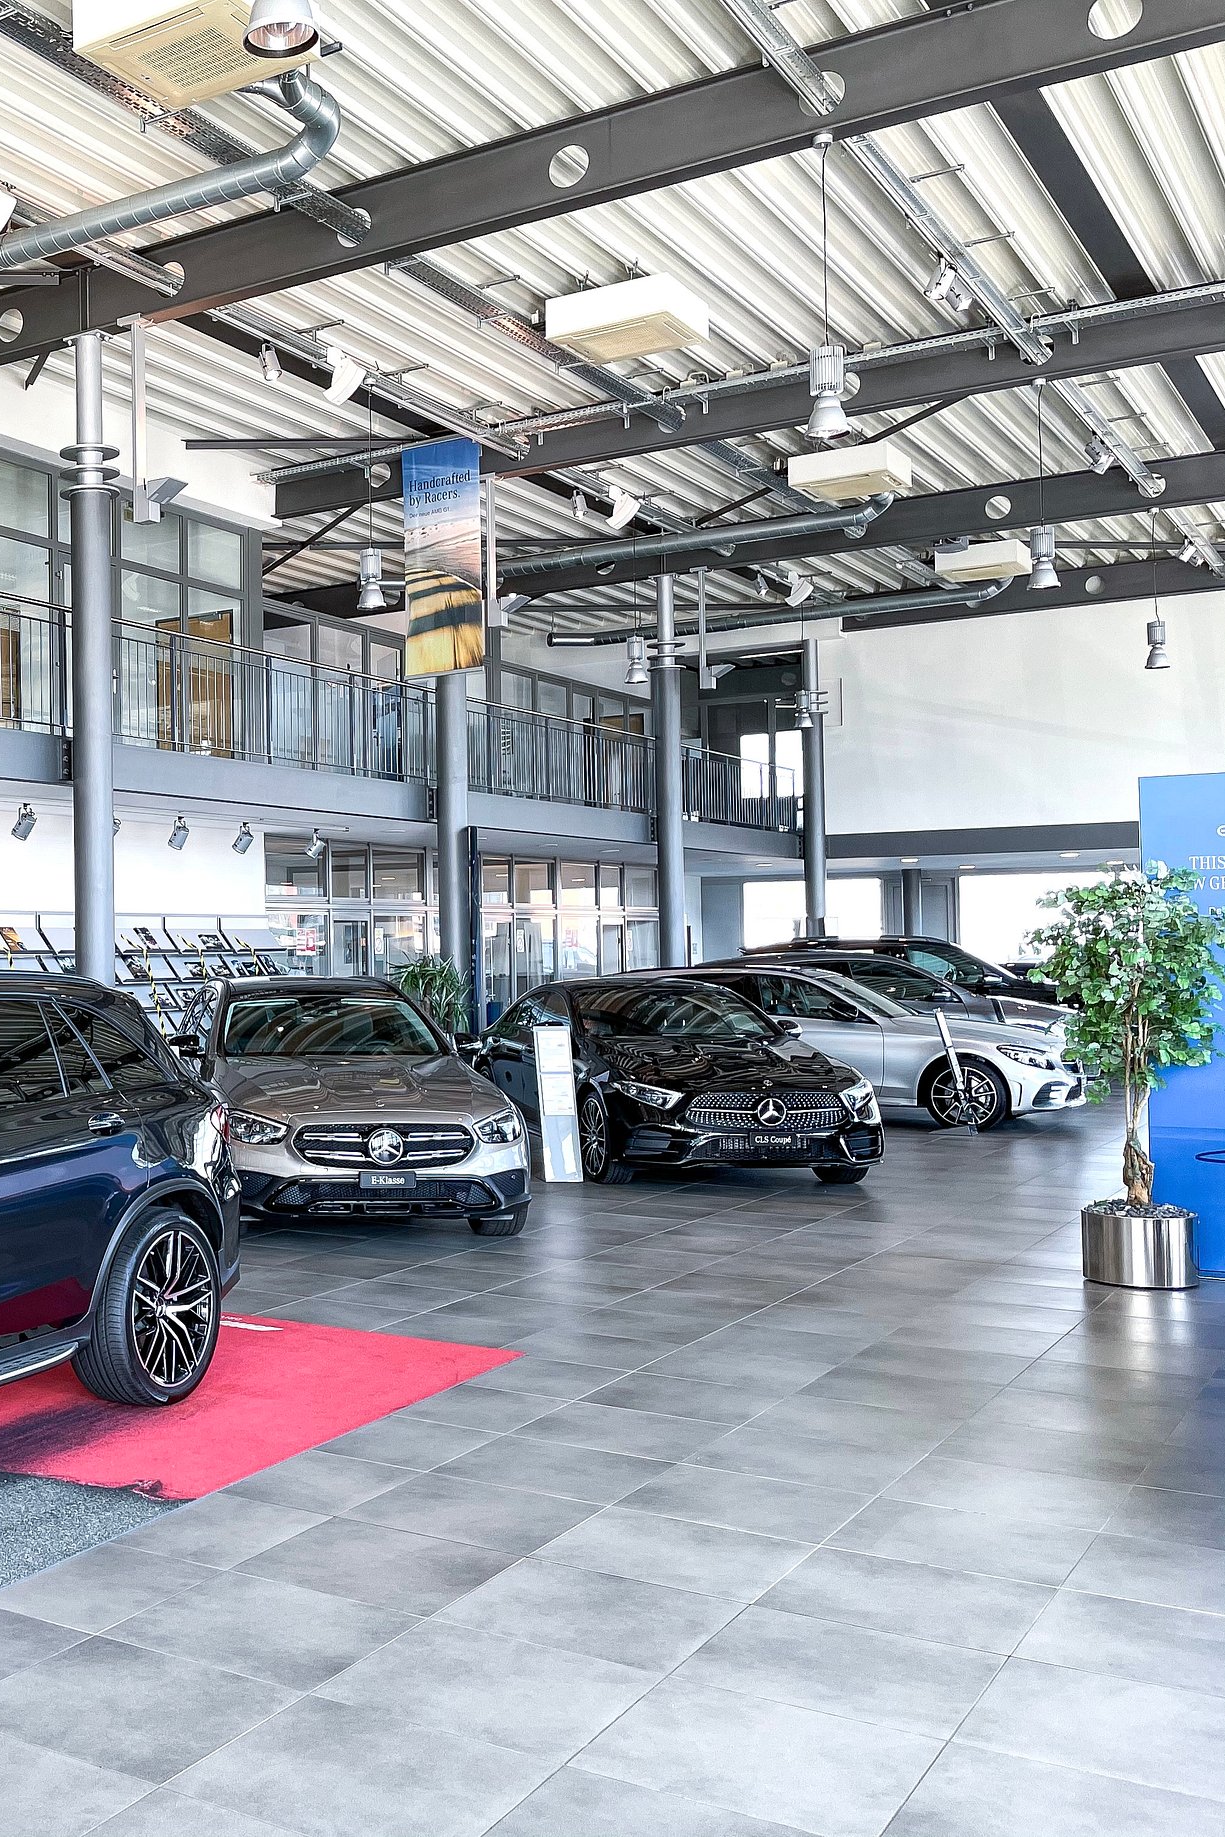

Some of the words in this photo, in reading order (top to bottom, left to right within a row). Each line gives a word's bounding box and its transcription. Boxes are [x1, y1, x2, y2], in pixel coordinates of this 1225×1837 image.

[409, 470, 471, 492] Handcrafted
[409, 494, 421, 509] by
[424, 489, 461, 504] Racers.
[755, 1135, 769, 1143] CLS
[371, 1175, 405, 1185] E-Klasse
